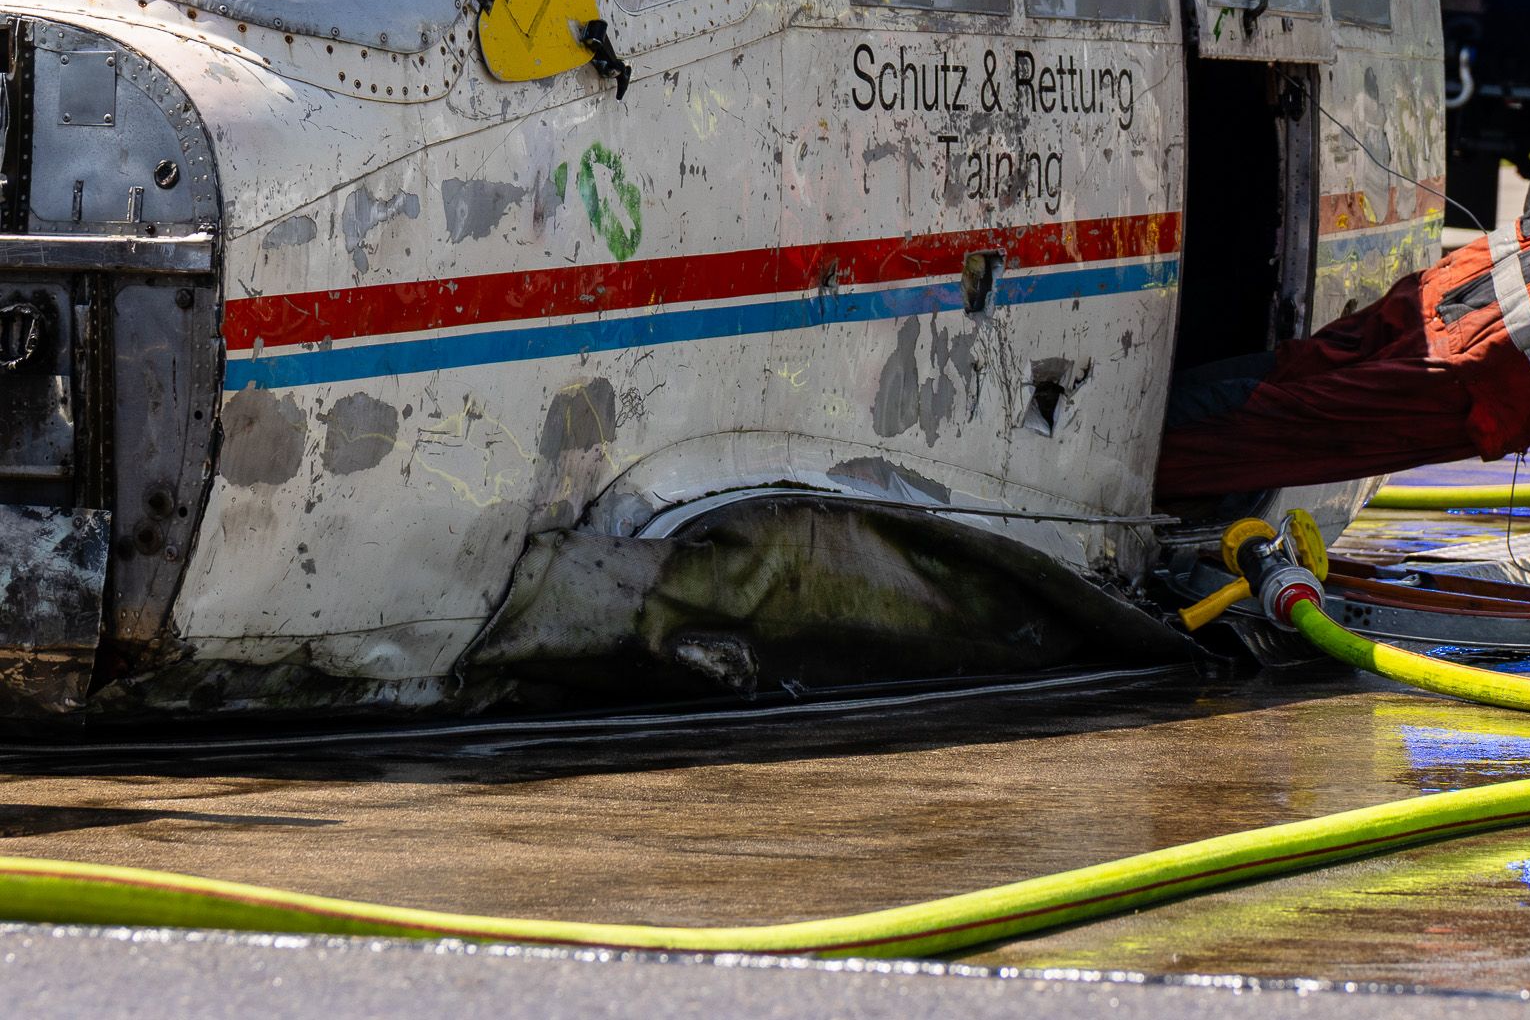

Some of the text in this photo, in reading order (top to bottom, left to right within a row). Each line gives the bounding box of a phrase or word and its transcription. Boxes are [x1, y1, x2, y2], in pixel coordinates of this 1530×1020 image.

[852, 43, 1134, 131] Schutz & Rettung
[937, 135, 1063, 216] Taining
